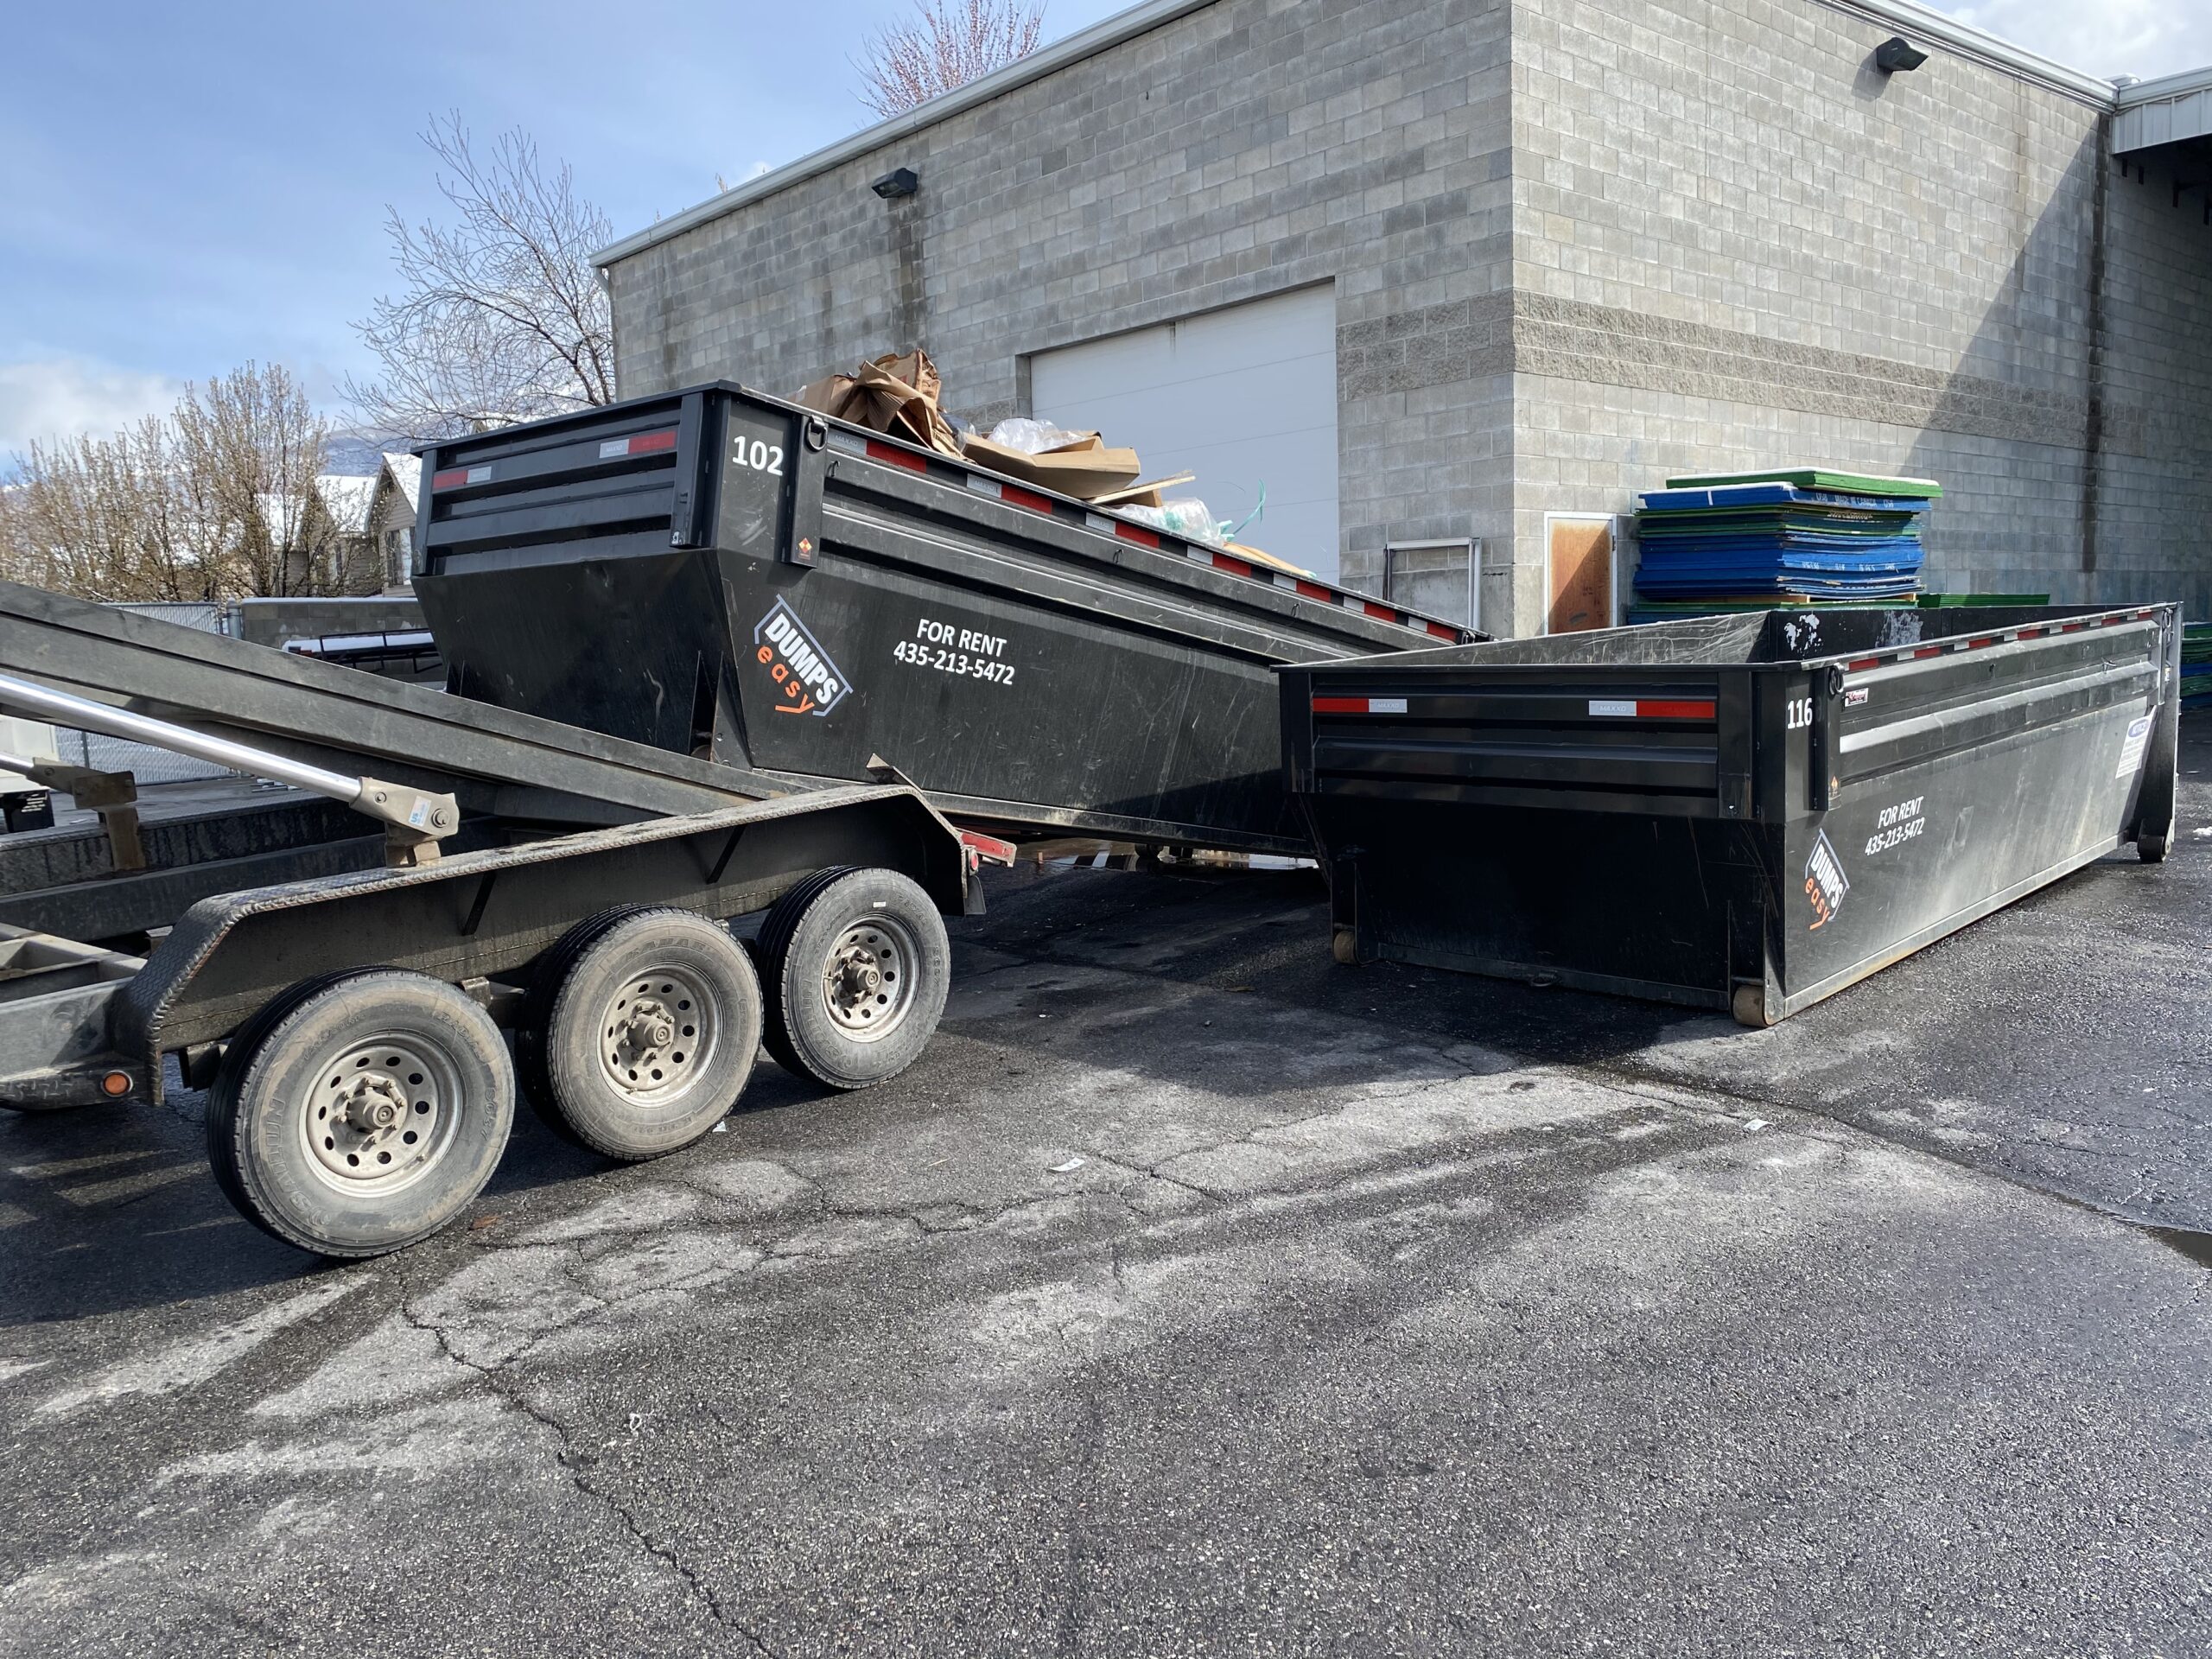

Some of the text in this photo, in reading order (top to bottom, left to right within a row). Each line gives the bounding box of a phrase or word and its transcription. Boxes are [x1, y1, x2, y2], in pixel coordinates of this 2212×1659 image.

[732, 435, 784, 476] 102
[764, 612, 838, 704] DUMPS
[917, 619, 1007, 658] FOR RENT
[757, 646, 814, 714] easy
[893, 641, 1015, 685] 435-213-5472
[1787, 697, 1812, 729] 116
[1878, 796, 1924, 830] FOR RENT
[1865, 817, 1925, 856] 435-213-5472
[1810, 842, 1844, 909] DUMPS
[1805, 877, 1830, 931] easy
